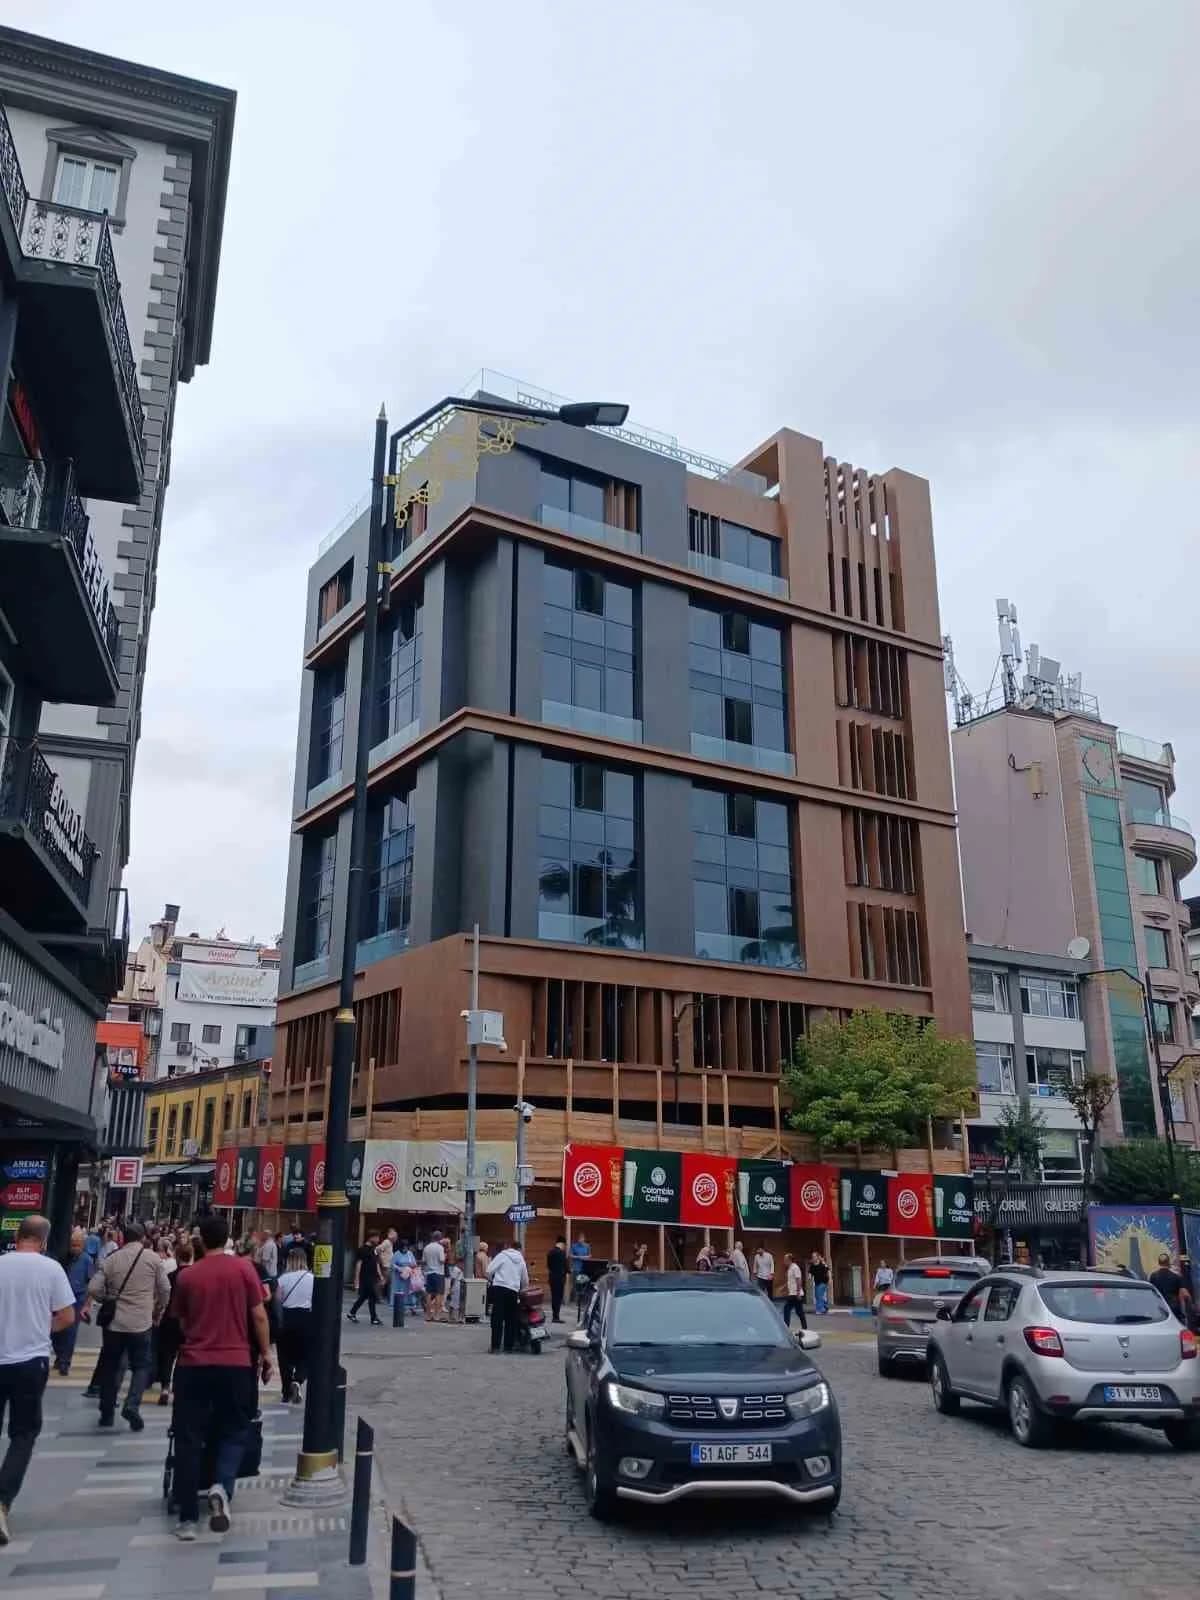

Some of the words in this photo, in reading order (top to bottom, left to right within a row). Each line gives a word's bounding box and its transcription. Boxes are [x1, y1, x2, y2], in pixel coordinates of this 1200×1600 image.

[412, 1180, 449, 1193] GRUP
[641, 1185, 674, 1195] Colombia
[645, 1194, 669, 1203] Coffee
[1140, 1387, 1160, 1398] 458
[700, 1446, 713, 1461] 61
[718, 1446, 739, 1461] AGF
[746, 1446, 769, 1460] 544
